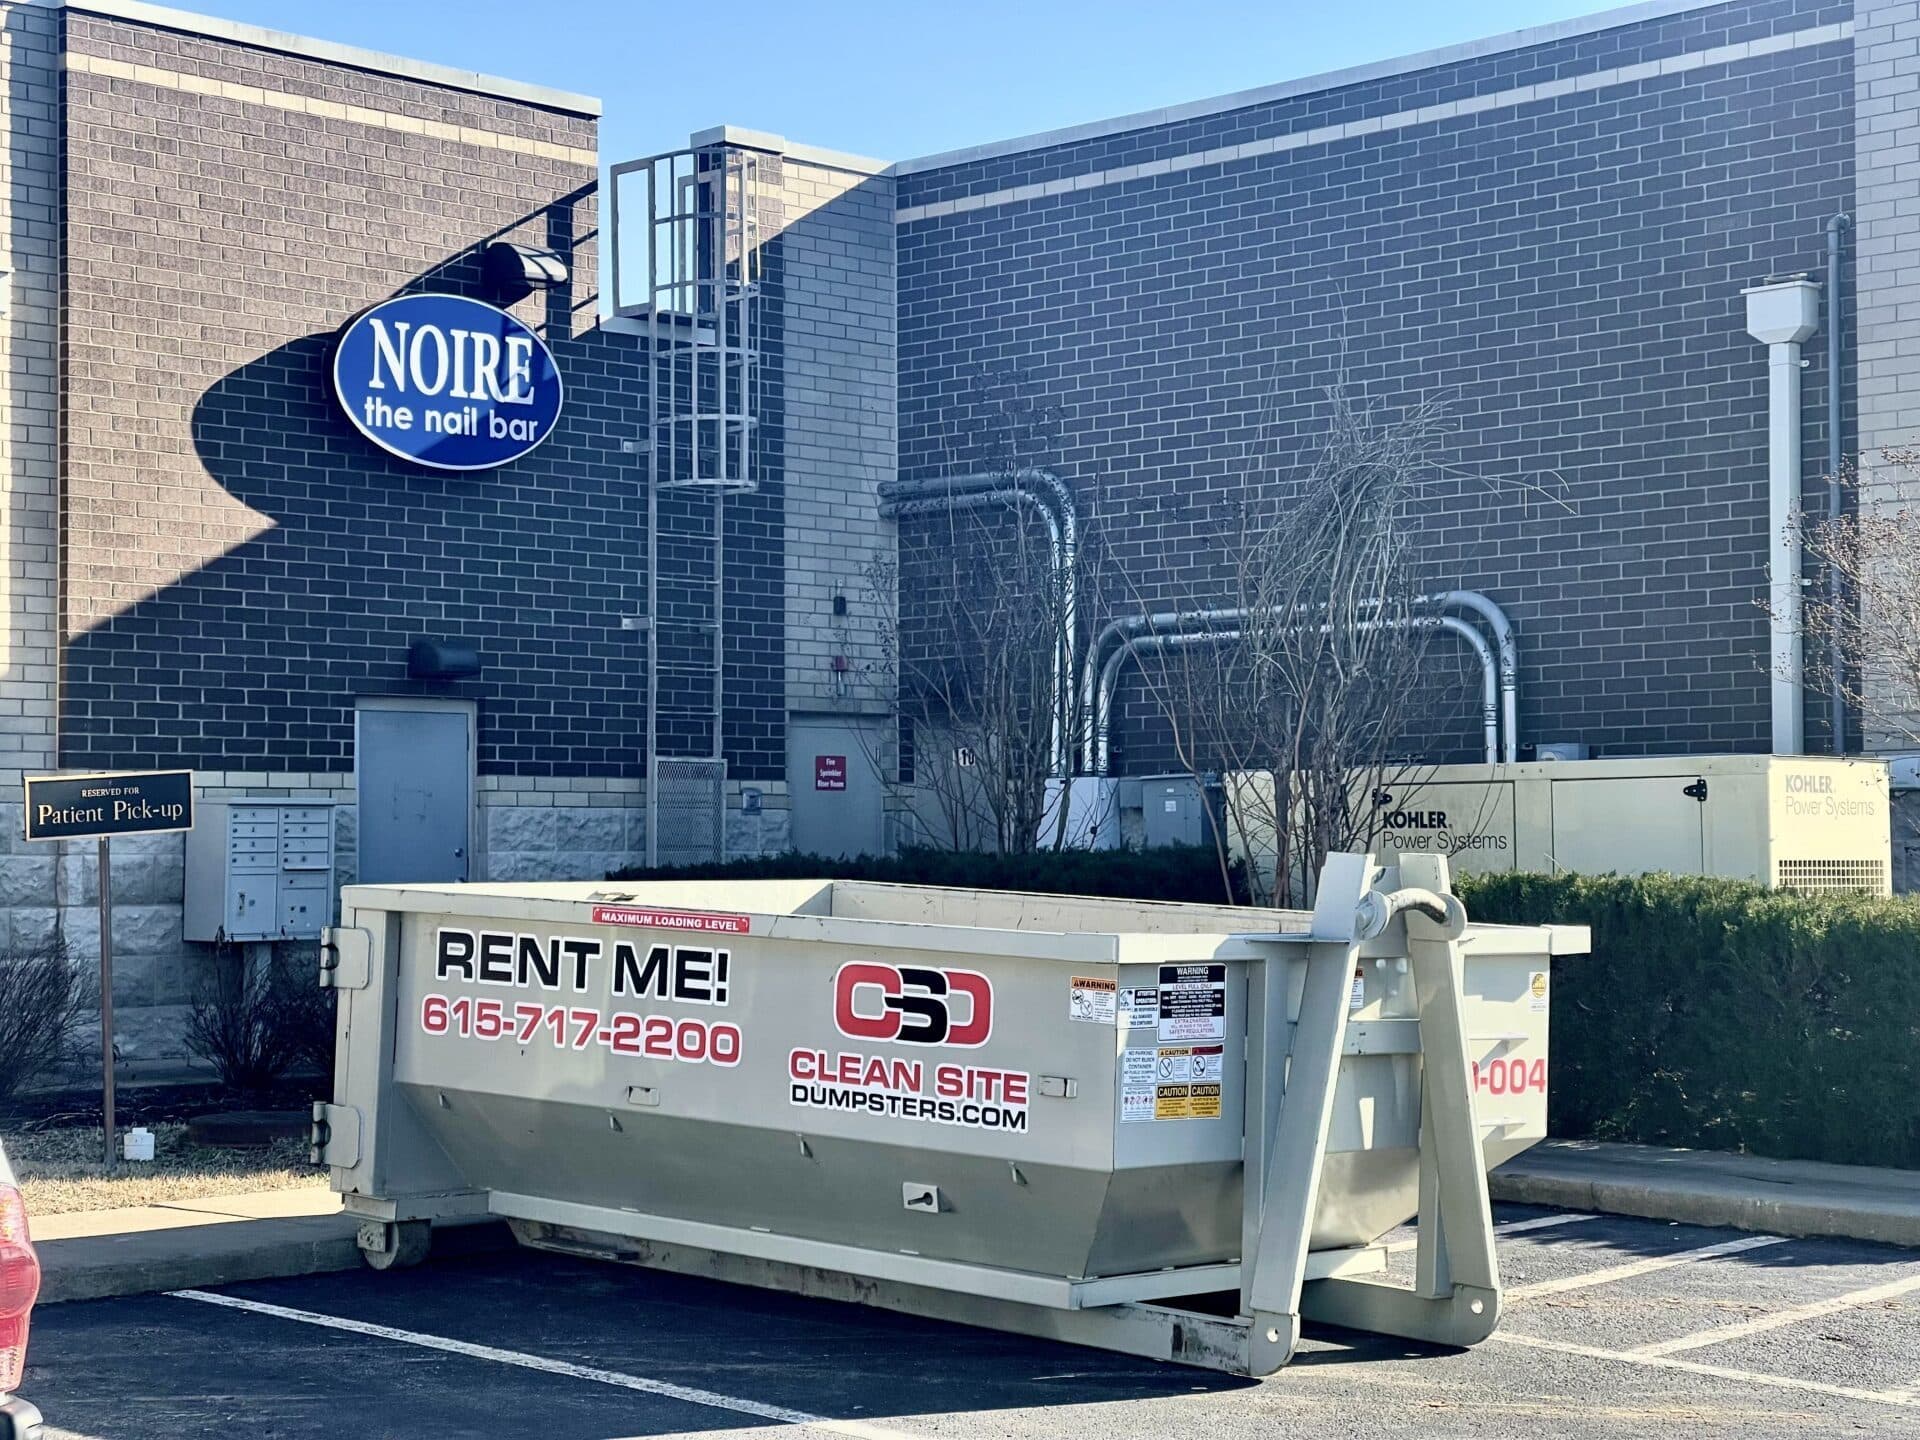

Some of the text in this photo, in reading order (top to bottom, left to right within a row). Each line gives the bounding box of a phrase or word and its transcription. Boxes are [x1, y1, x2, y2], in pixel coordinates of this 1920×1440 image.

[368, 317, 535, 405] NOIRE
[364, 396, 539, 442] the nail bar
[81, 786, 140, 798] RESERVED FOR
[1785, 774, 1833, 794] KOHLER
[38, 798, 184, 826] Patient Pick-up
[1786, 796, 1875, 820] Power Systems
[1382, 811, 1448, 829] KOHLER
[1383, 831, 1508, 854] Power Systems
[601, 912, 740, 932] MAXIMUM LOADING LEVEL
[436, 928, 731, 1005] RENT ME!
[1176, 966, 1209, 976] WARNING
[1079, 980, 1116, 991] WARNING
[834, 962, 992, 1046] CSD
[422, 995, 742, 1067] 615-717-2200
[789, 1049, 1029, 1106] CLEAN SITE
[1158, 1087, 1188, 1097] CAUTION
[1191, 1085, 1219, 1096] CAUTION
[790, 1083, 1028, 1131] DUMPSTERS.COM
